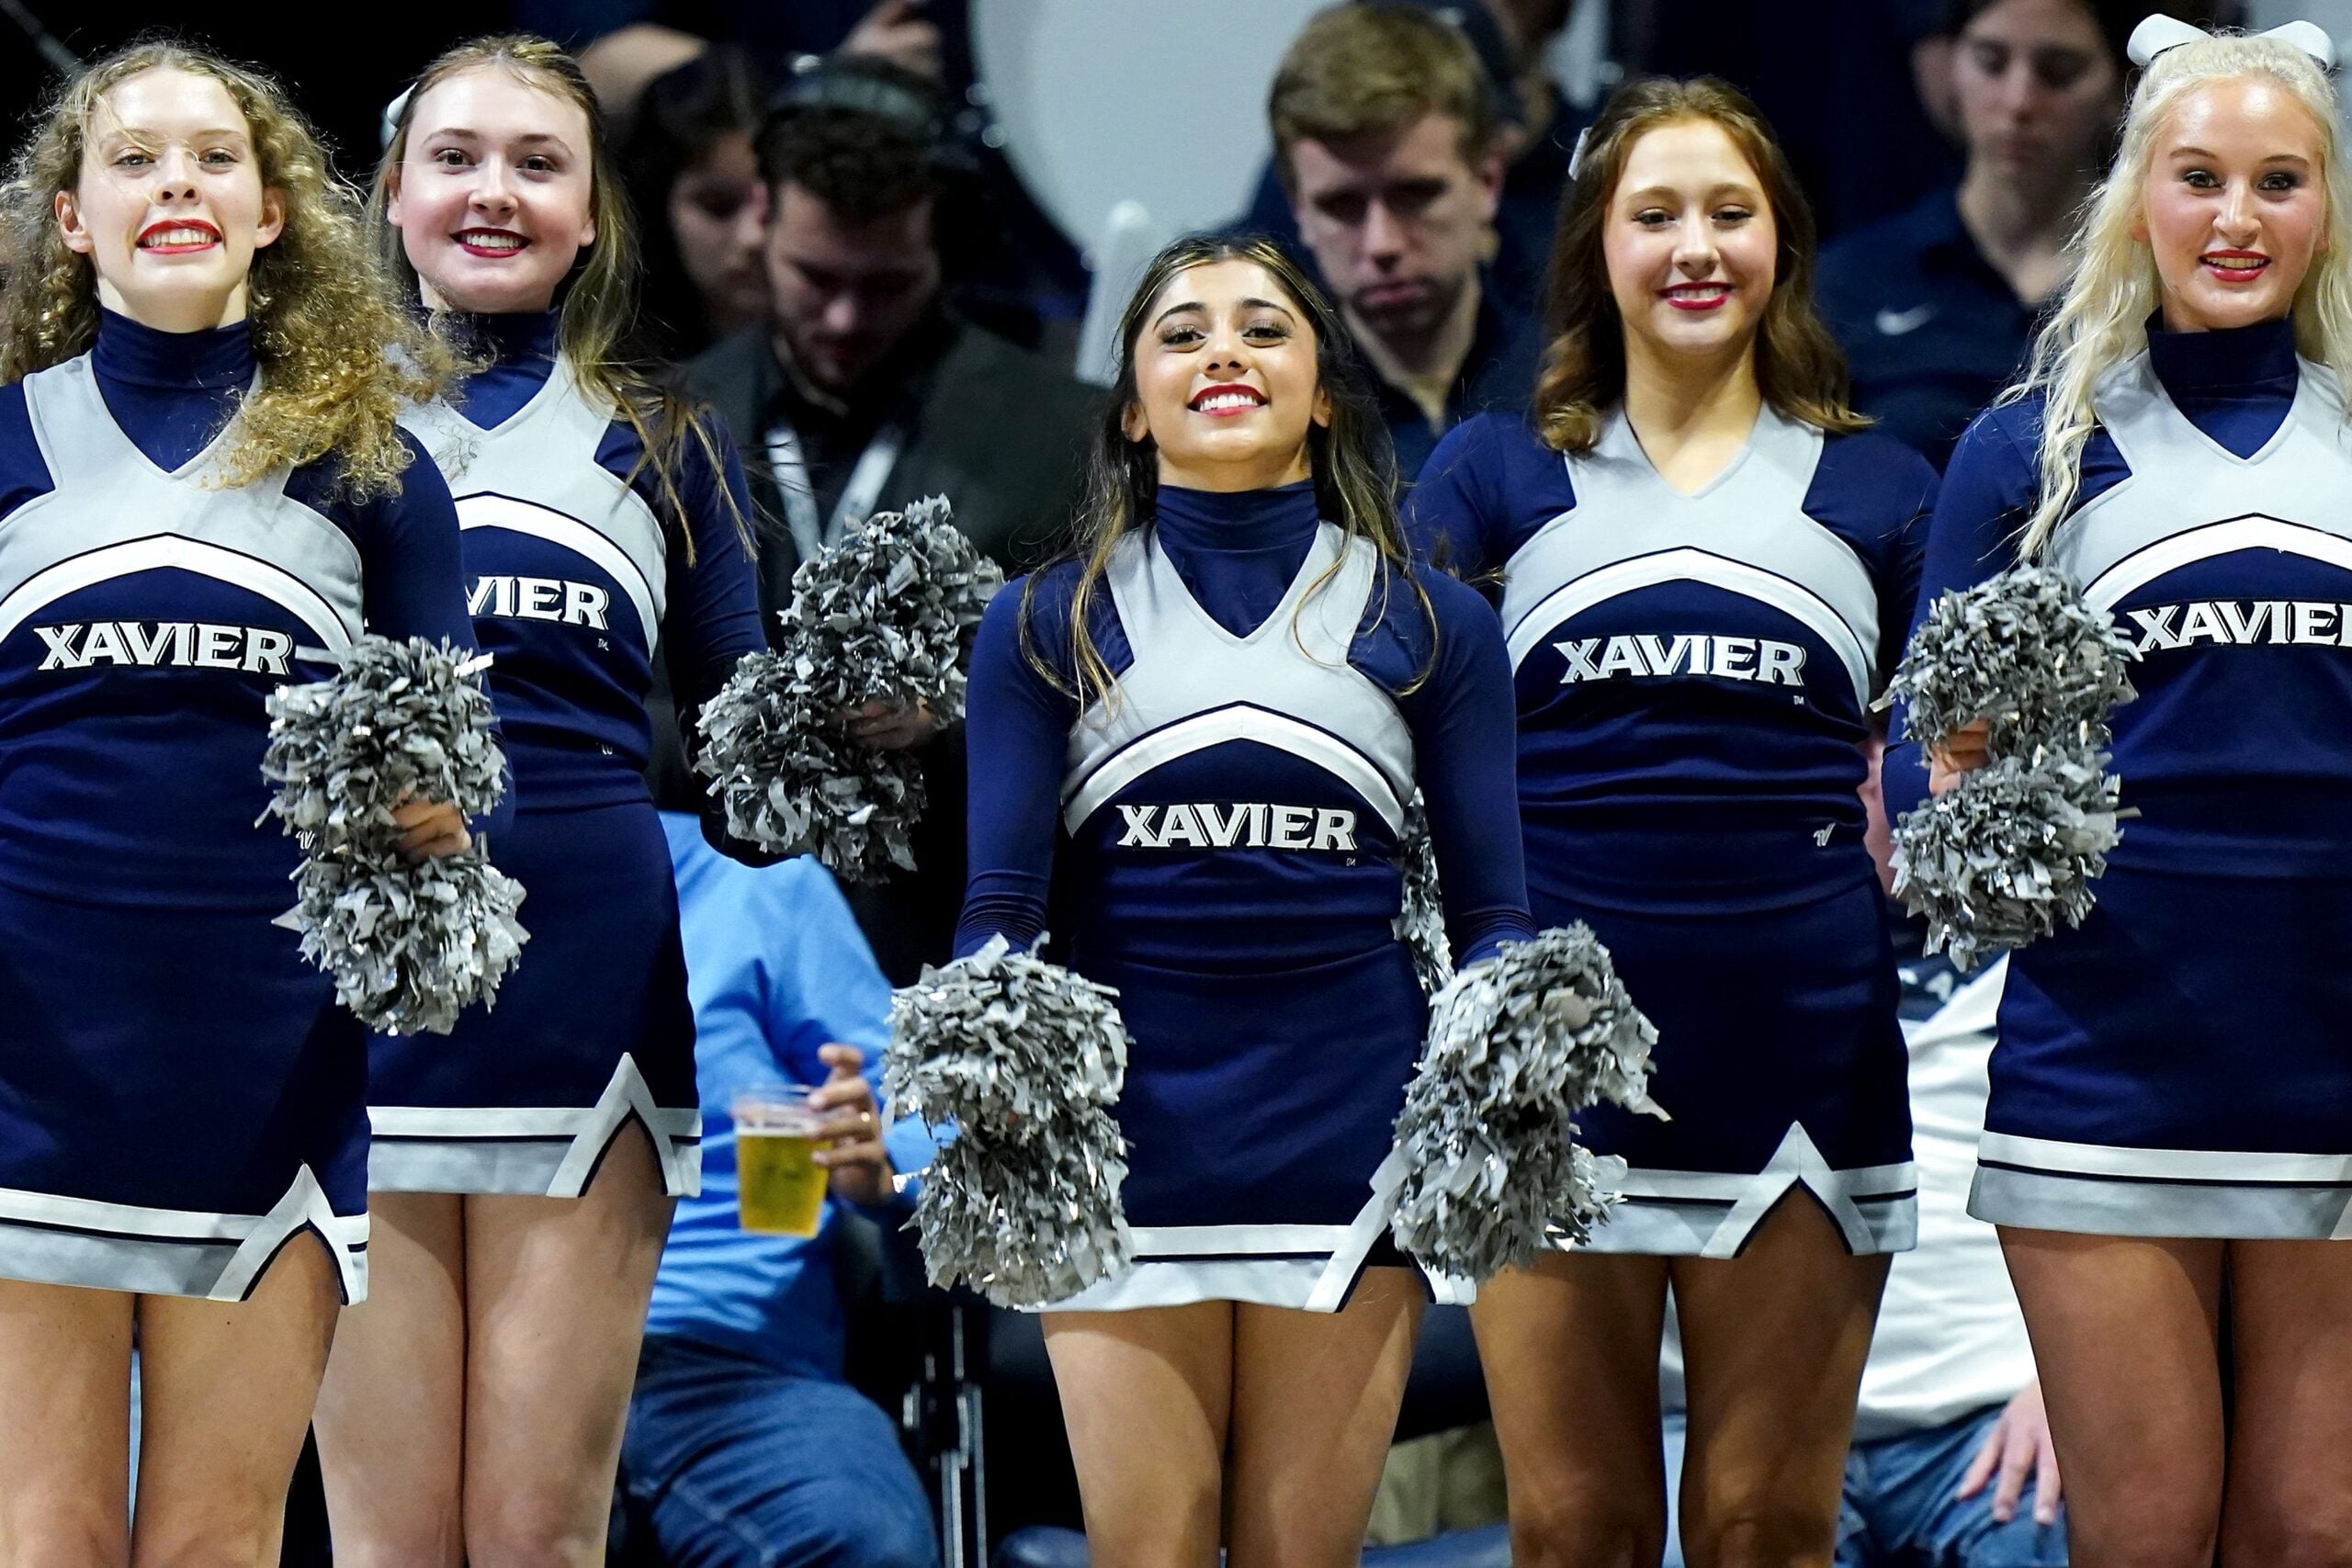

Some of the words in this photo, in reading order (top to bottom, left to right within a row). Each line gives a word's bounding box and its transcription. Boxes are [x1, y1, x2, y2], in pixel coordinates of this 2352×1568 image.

[465, 576, 609, 630] VIER
[2127, 601, 2352, 653] XAVIE
[33, 621, 293, 675] XAVIER
[1553, 635, 1806, 686] XAVIER
[1115, 803, 1358, 851] XAVIER
